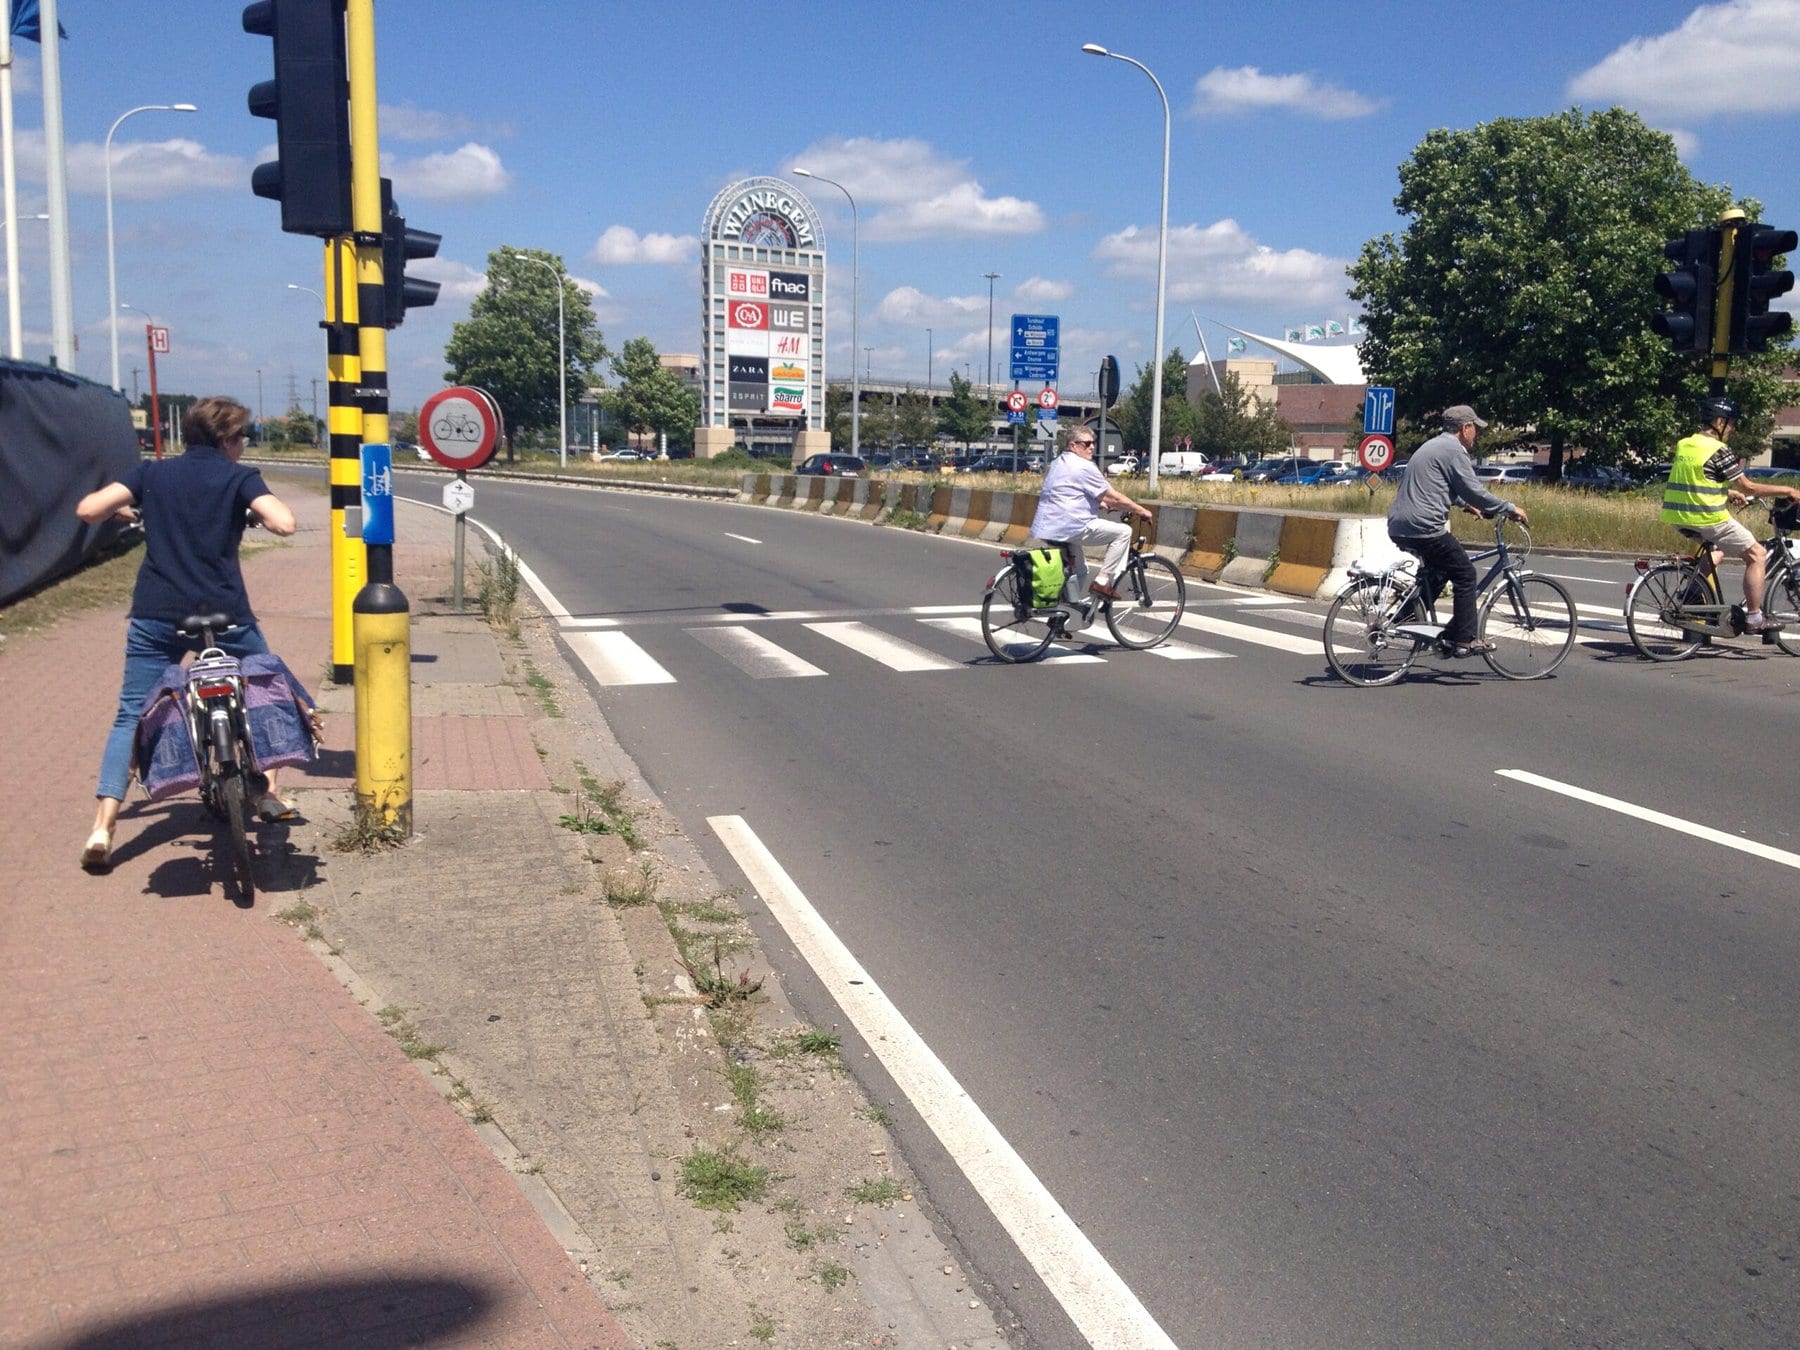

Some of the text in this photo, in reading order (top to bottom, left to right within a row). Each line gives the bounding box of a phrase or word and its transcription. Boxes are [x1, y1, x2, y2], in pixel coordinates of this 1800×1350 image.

[724, 191, 814, 247] WIJNEGEM
[771, 278, 806, 294] fnac
[773, 309, 805, 328] WE
[154, 331, 166, 349] H
[777, 336, 800, 354] H&M
[733, 365, 764, 374] ZARA
[732, 392, 764, 401] ESPRIT
[774, 392, 802, 403] sbarro
[1368, 444, 1386, 457] 70
